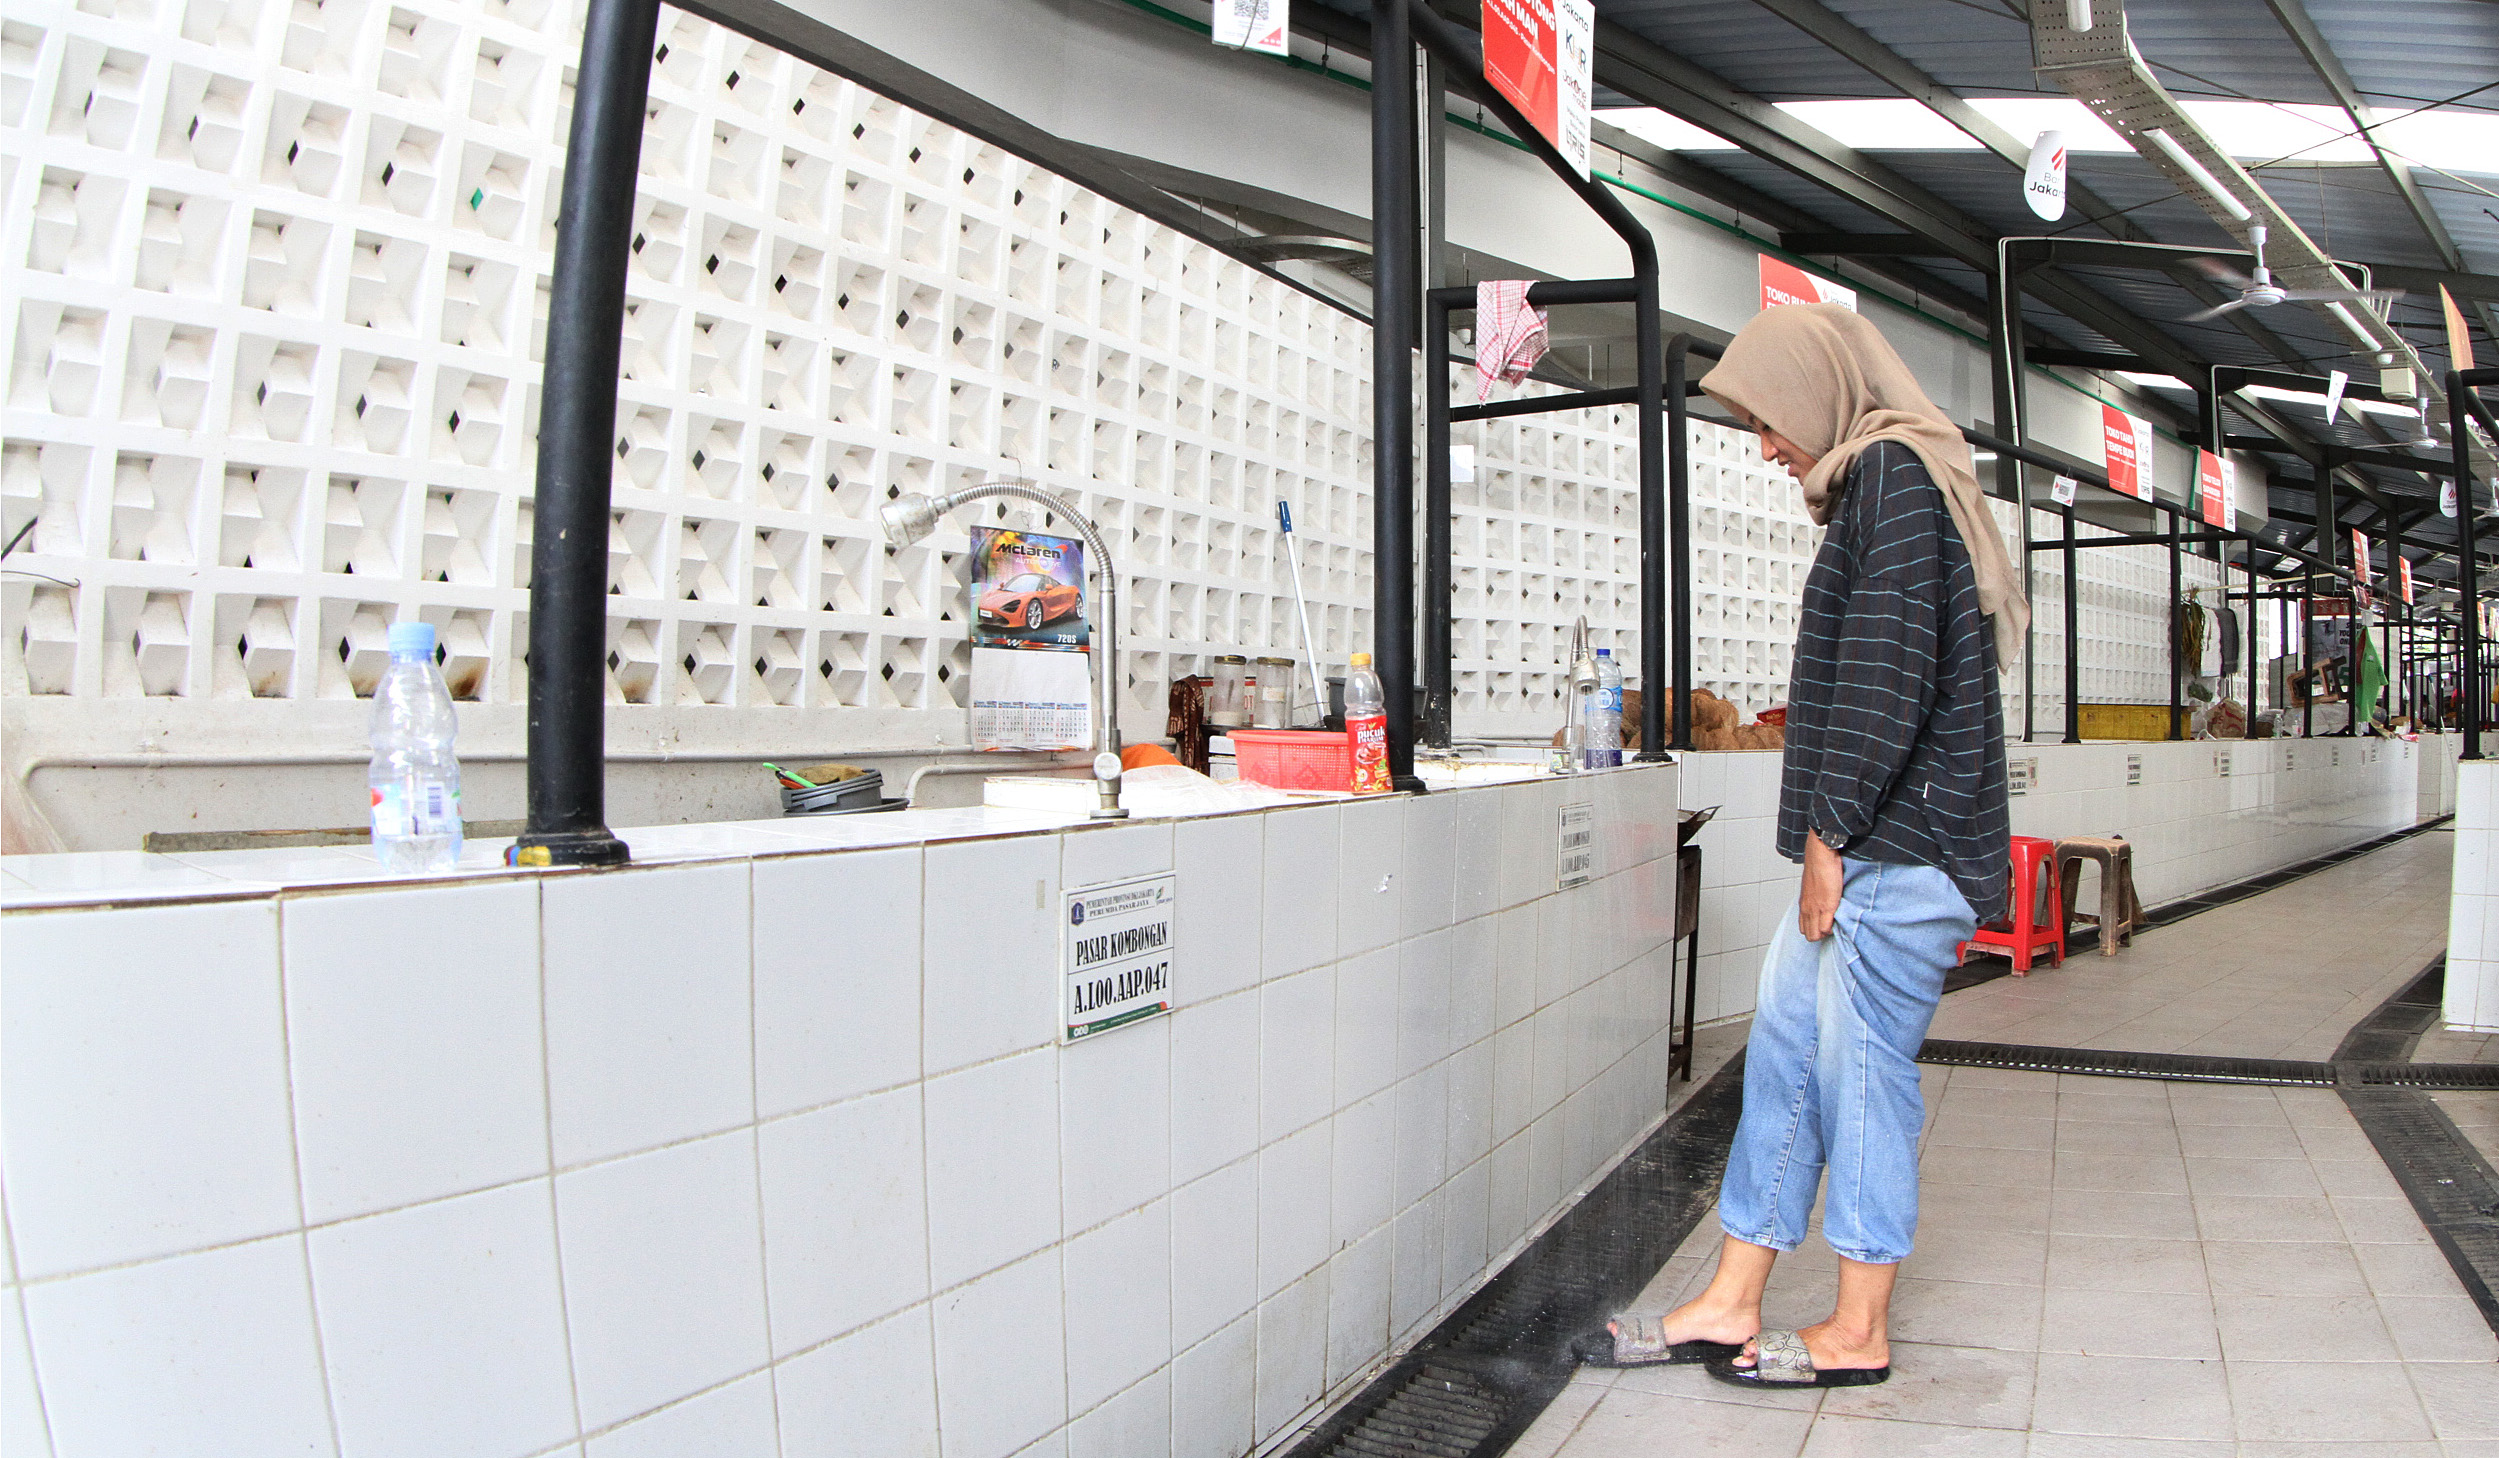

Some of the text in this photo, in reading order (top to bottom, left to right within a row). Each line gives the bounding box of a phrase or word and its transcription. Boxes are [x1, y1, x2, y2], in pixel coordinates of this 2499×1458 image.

[1516, 3, 1539, 40] MAN
[1562, 1, 1589, 33] Jakarta
[1765, 285, 1790, 305] TOKO
[2105, 425, 2121, 440] TOKO
[2106, 440, 2124, 457] TEMPE
[995, 543, 1063, 560] McLaren
[1057, 633, 1078, 644] 720S
[1357, 725, 1386, 744] pucuk
[1118, 902, 1136, 912] PASAR
[1134, 900, 1150, 909] JAYA
[1076, 921, 1168, 967] PASAR KOMBONGAN
